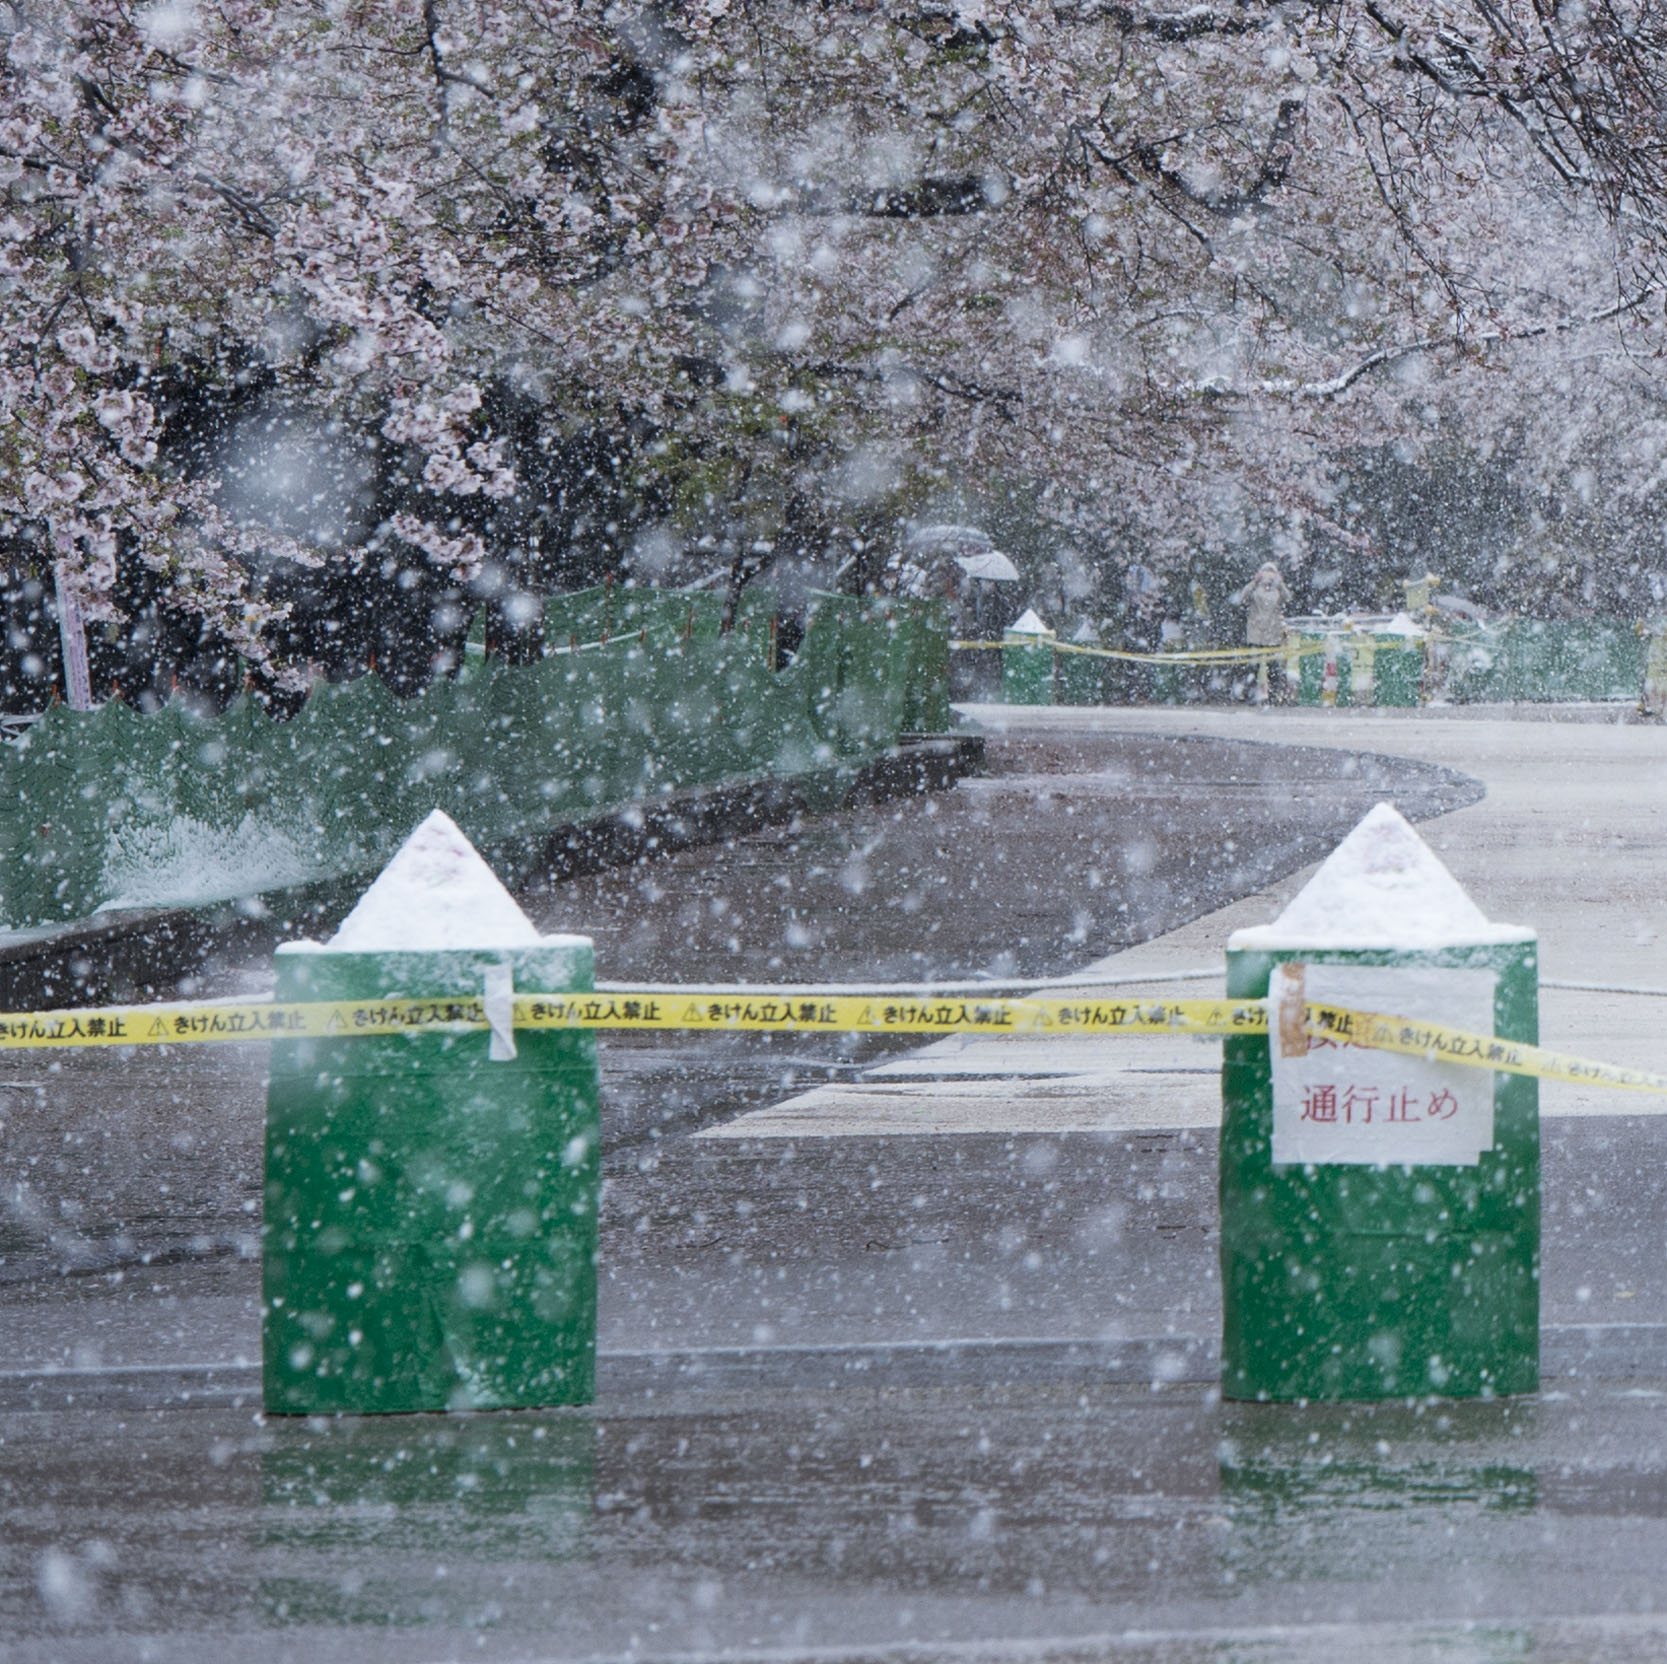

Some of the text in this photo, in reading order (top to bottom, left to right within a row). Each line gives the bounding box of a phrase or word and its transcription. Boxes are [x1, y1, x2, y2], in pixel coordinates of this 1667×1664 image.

[173, 1008, 306, 1034] きけん立入禁止
[352, 1002, 487, 1027] きけん立入禁止
[531, 1001, 661, 1021] きけん立入禁止
[707, 1003, 837, 1025] きけん立入禁止
[883, 1005, 1012, 1026] きけん立入禁止
[1058, 1005, 1186, 1026] きけん立入禁止
[1400, 1027, 1521, 1066] きけん立入禁止
[1300, 1084, 1459, 1124] 通行止め
